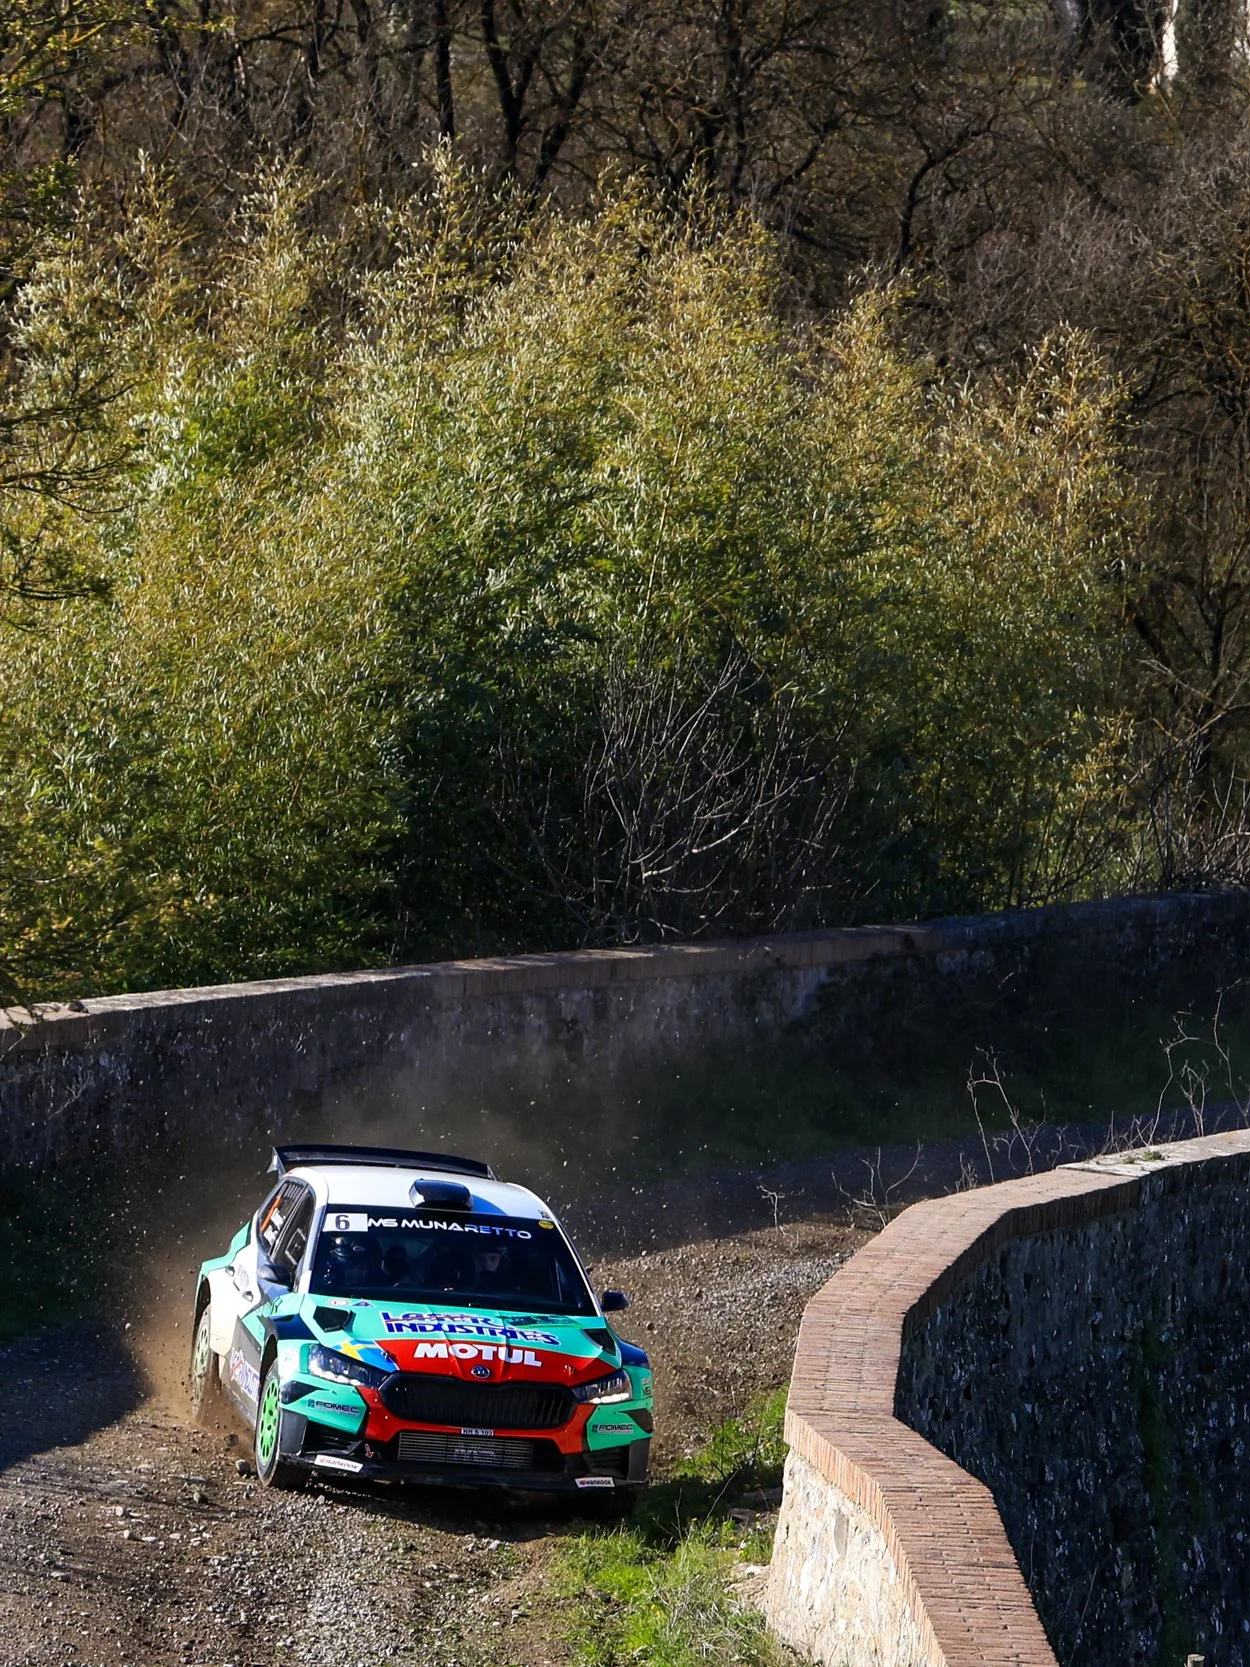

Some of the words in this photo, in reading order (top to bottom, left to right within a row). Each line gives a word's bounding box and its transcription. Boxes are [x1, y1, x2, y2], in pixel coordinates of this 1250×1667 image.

[334, 1214, 351, 1231] 6
[368, 1217, 398, 1228] MS
[401, 1219, 532, 1240] MUNARETTO
[385, 1323, 562, 1347] INDUSTRIES
[413, 1342, 542, 1367] MOTUL
[315, 1399, 361, 1413] FOMEC
